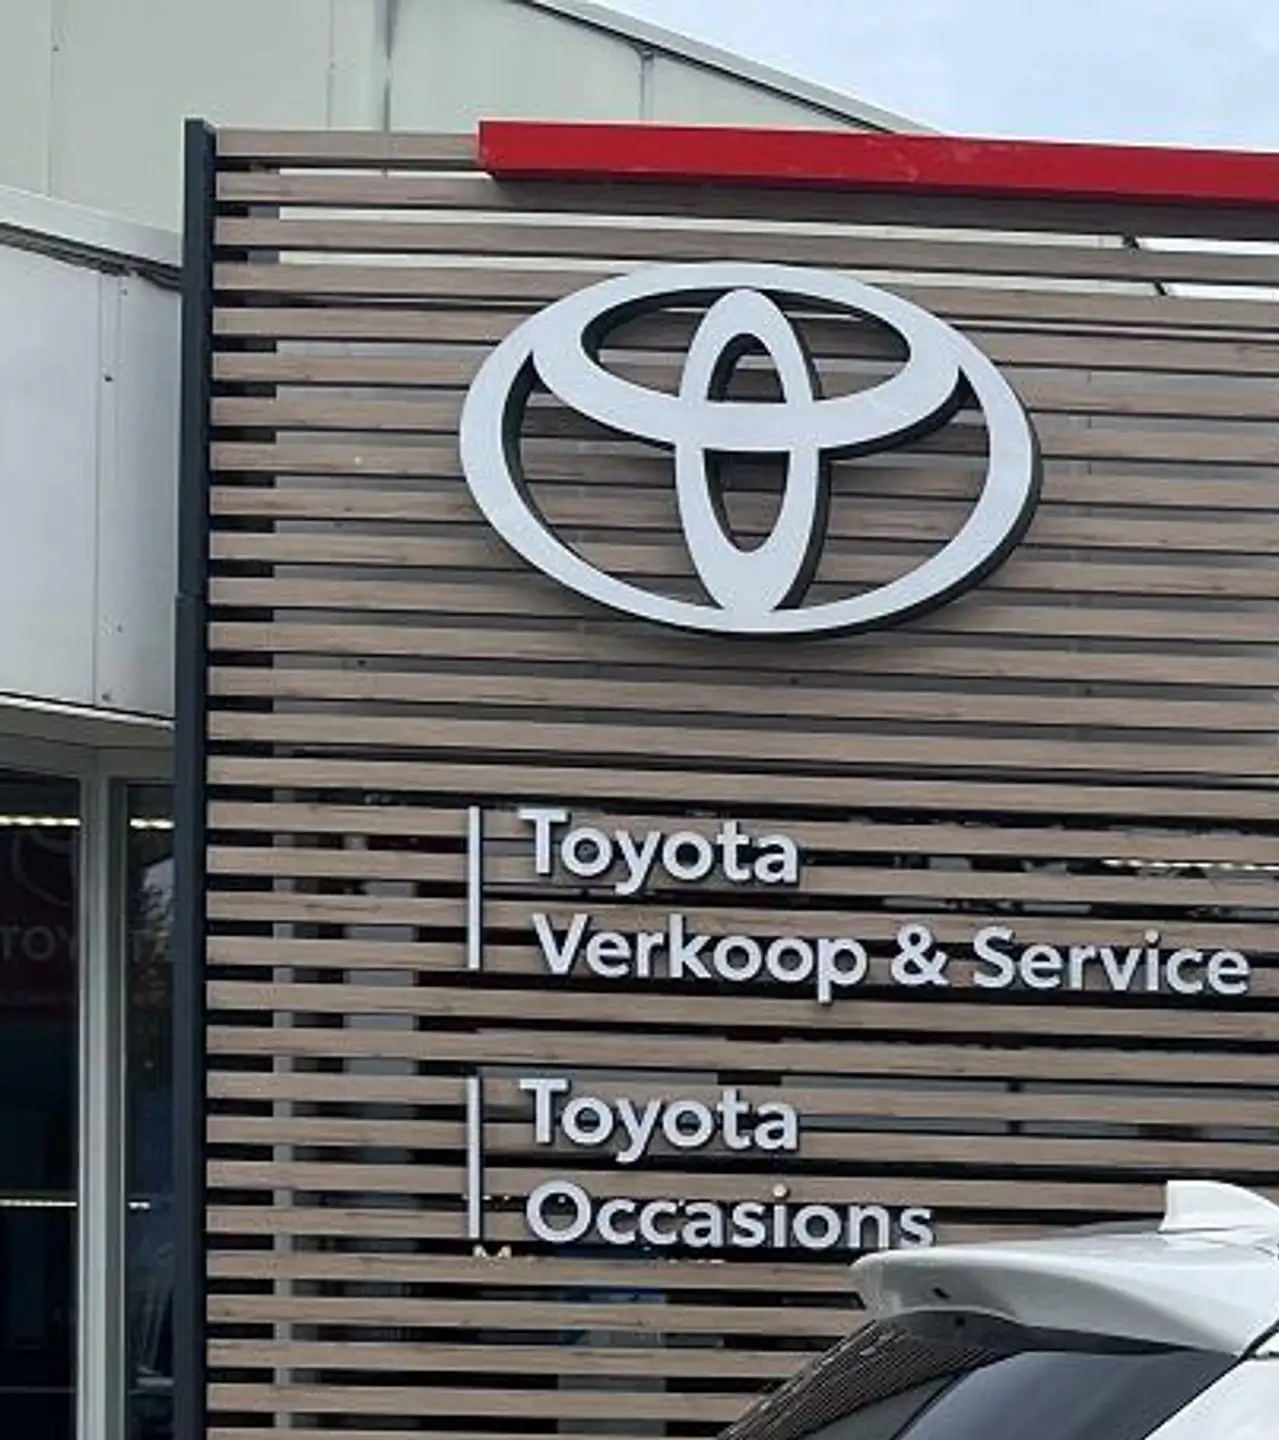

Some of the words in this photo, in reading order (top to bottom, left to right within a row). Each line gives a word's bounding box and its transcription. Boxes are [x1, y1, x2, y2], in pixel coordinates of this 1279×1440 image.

[518, 807, 801, 894] Toyota
[531, 912, 868, 1004] Verkoop
[889, 923, 949, 987] &
[972, 924, 1252, 995] Service
[518, 1077, 801, 1163] Toyota
[525, 1179, 937, 1250] Occasions
